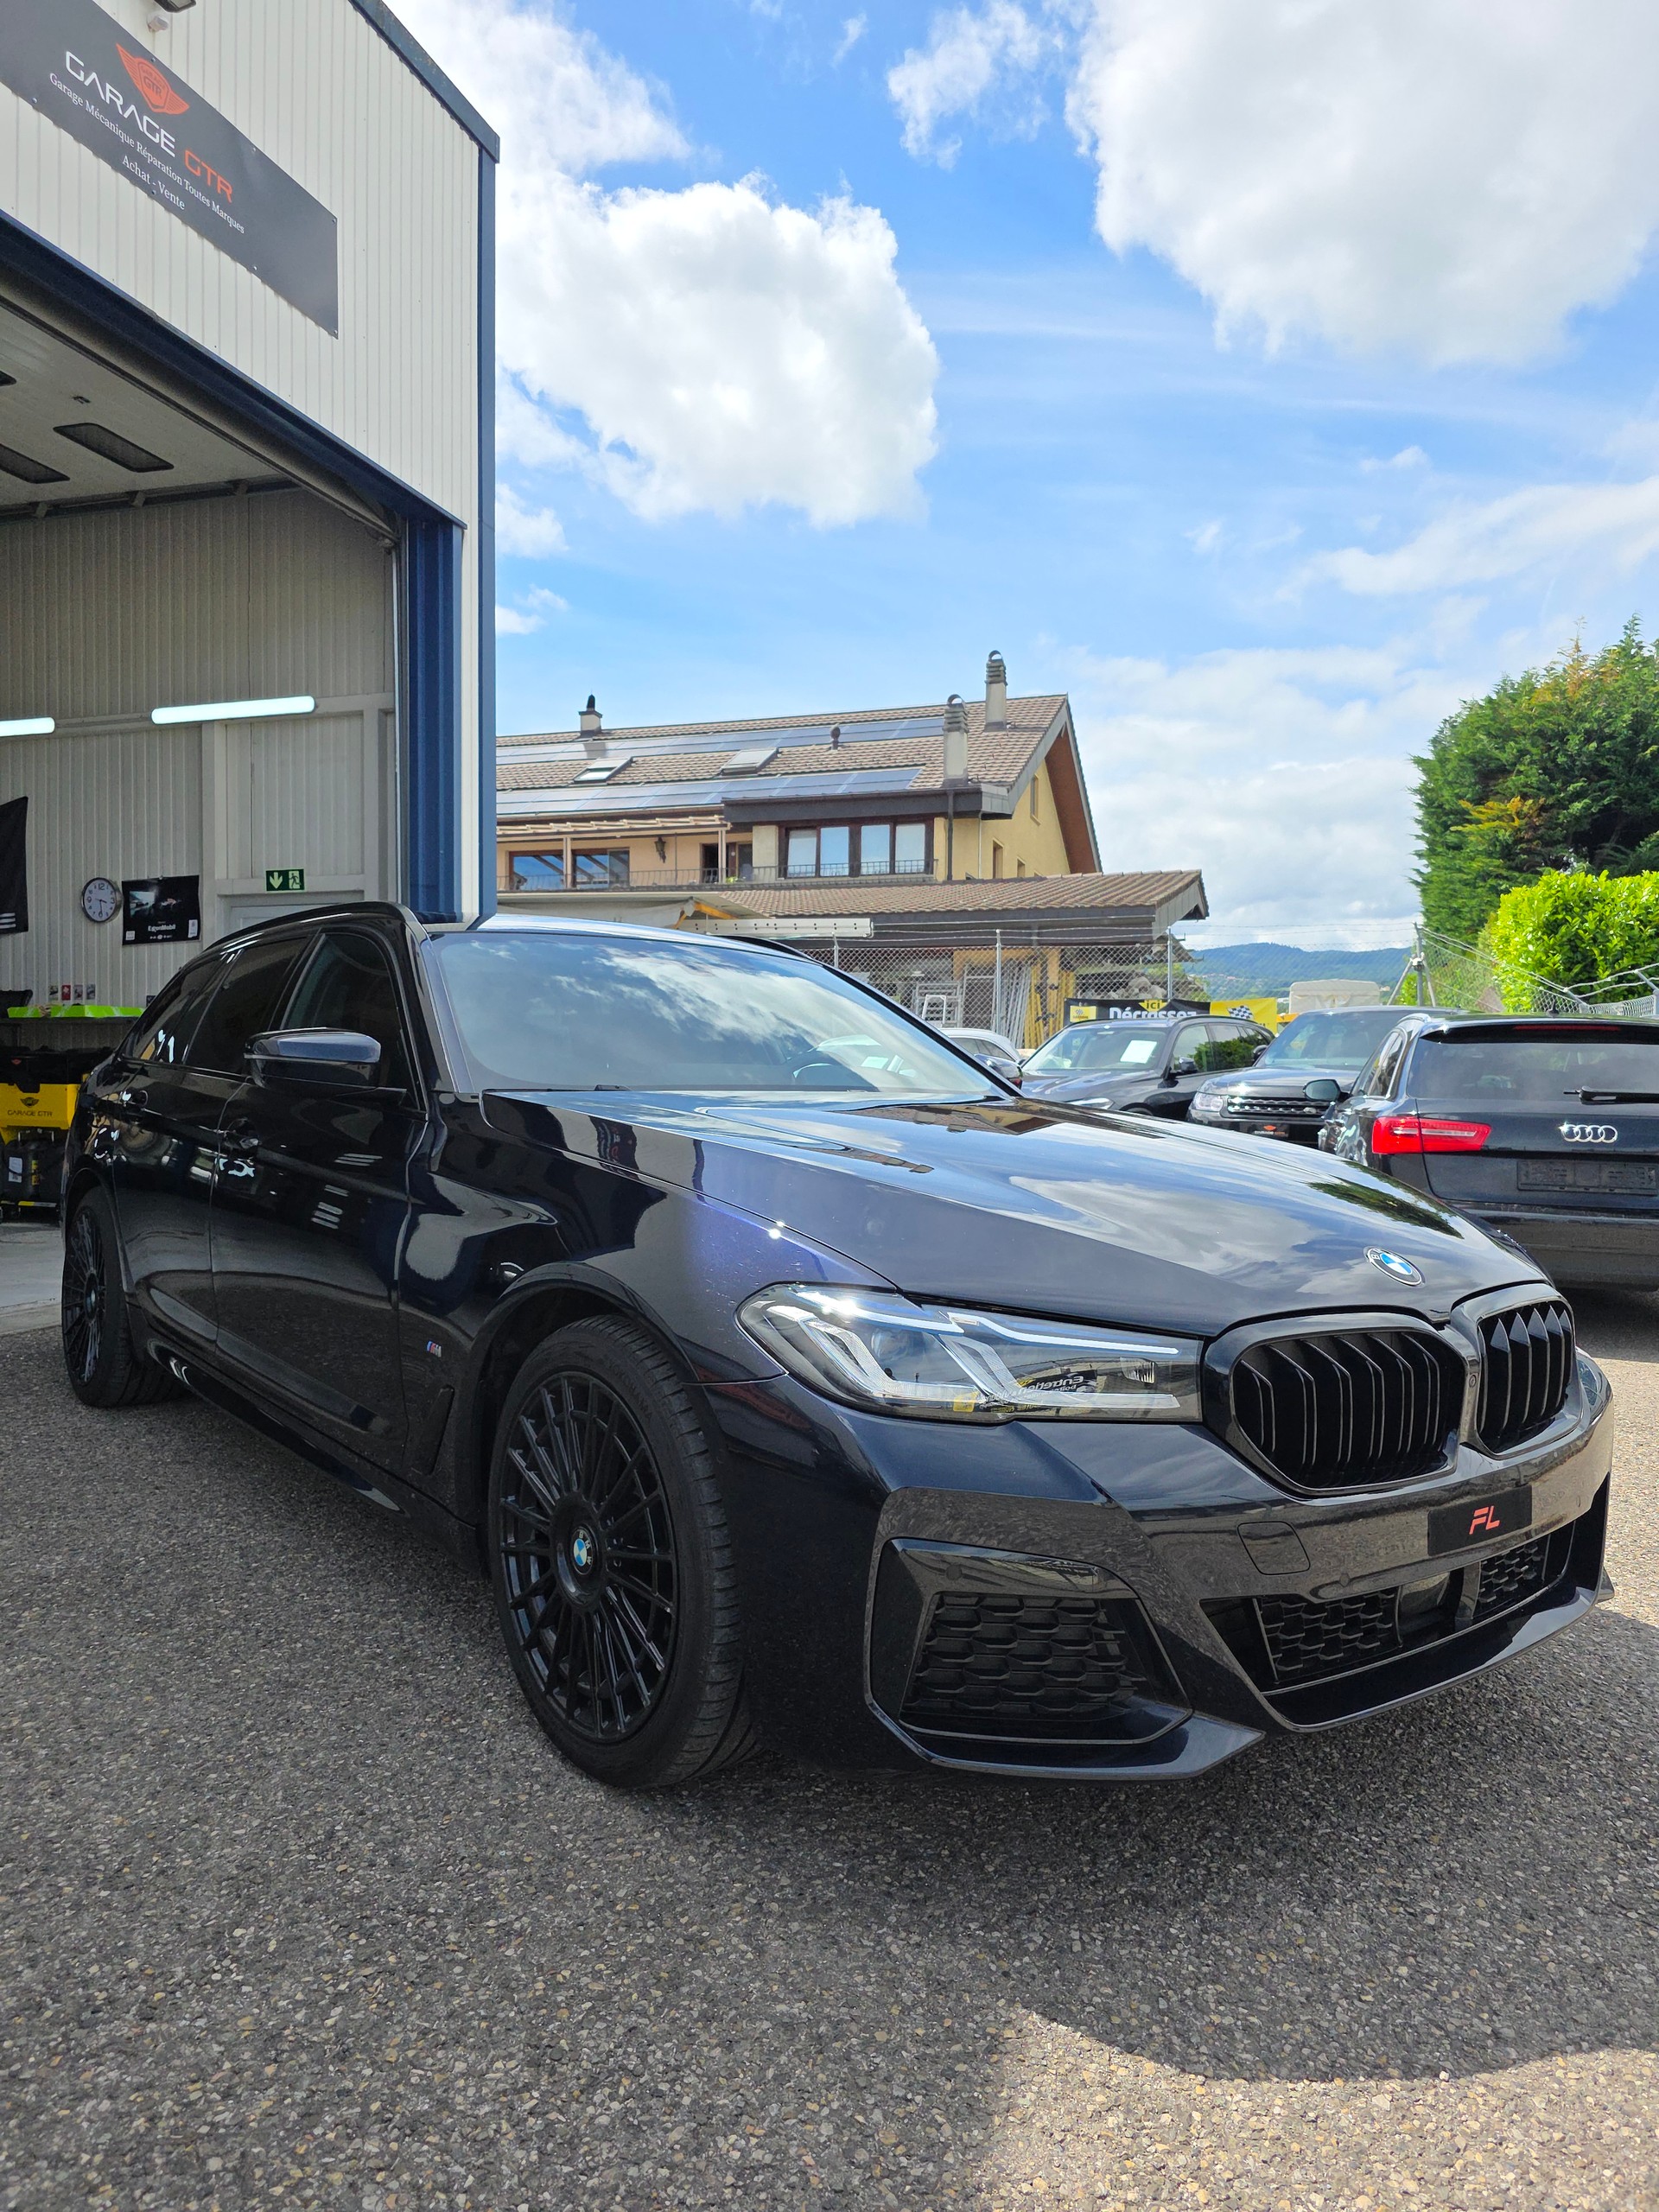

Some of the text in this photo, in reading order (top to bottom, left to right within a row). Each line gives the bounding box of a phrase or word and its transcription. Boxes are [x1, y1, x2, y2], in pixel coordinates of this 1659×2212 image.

[49, 73, 245, 234] Garage Mécanique Réparation Toutes Marques
[66, 50, 233, 204] GARAGE GTR
[122, 155, 150, 186] Achat
[157, 180, 186, 211] Vente
[98, 882, 105, 891] 12
[1469, 1505, 1500, 1535] FL
